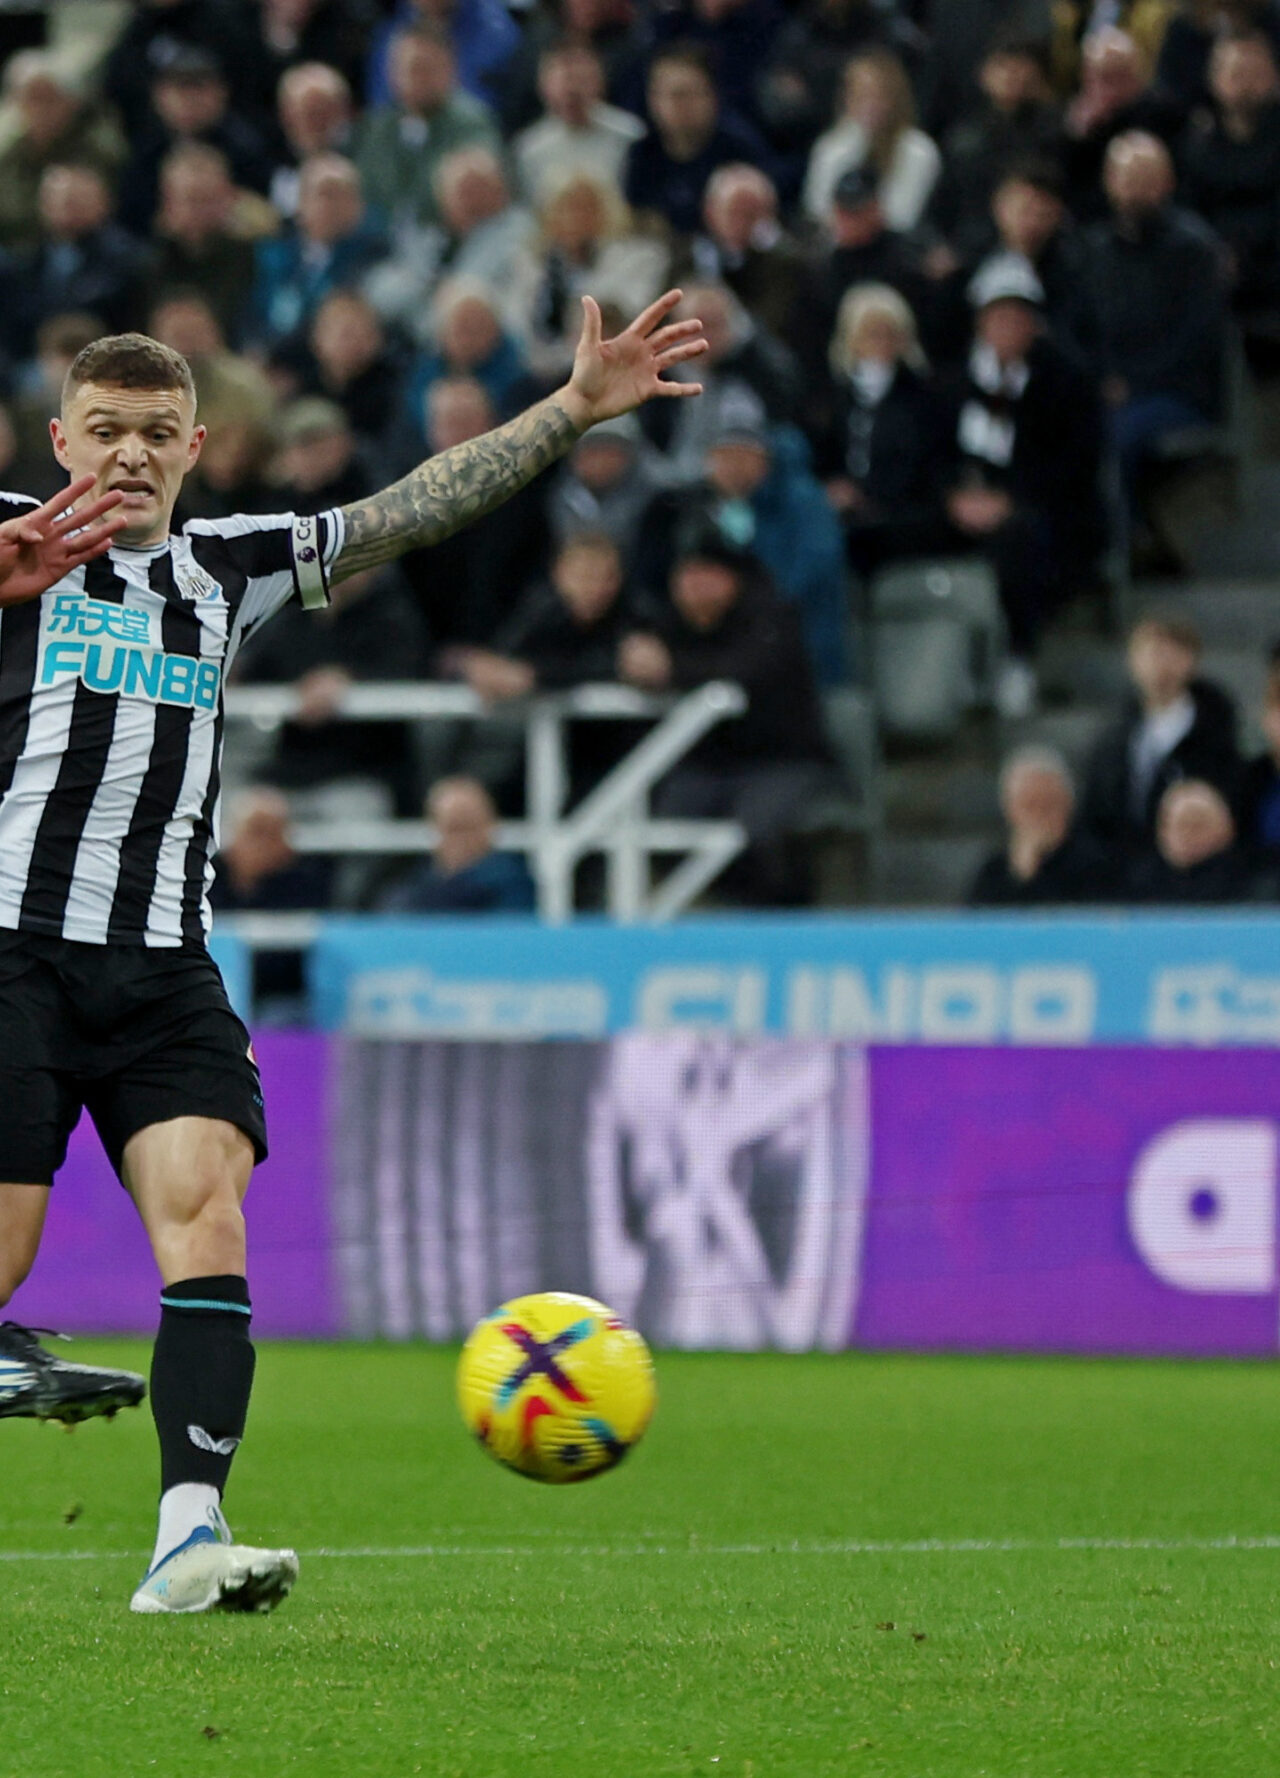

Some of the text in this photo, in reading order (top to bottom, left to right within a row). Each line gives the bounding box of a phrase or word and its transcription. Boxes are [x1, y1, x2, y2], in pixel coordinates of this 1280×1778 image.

[47, 594, 150, 645] 乐天堂
[41, 641, 220, 710] FUN88
